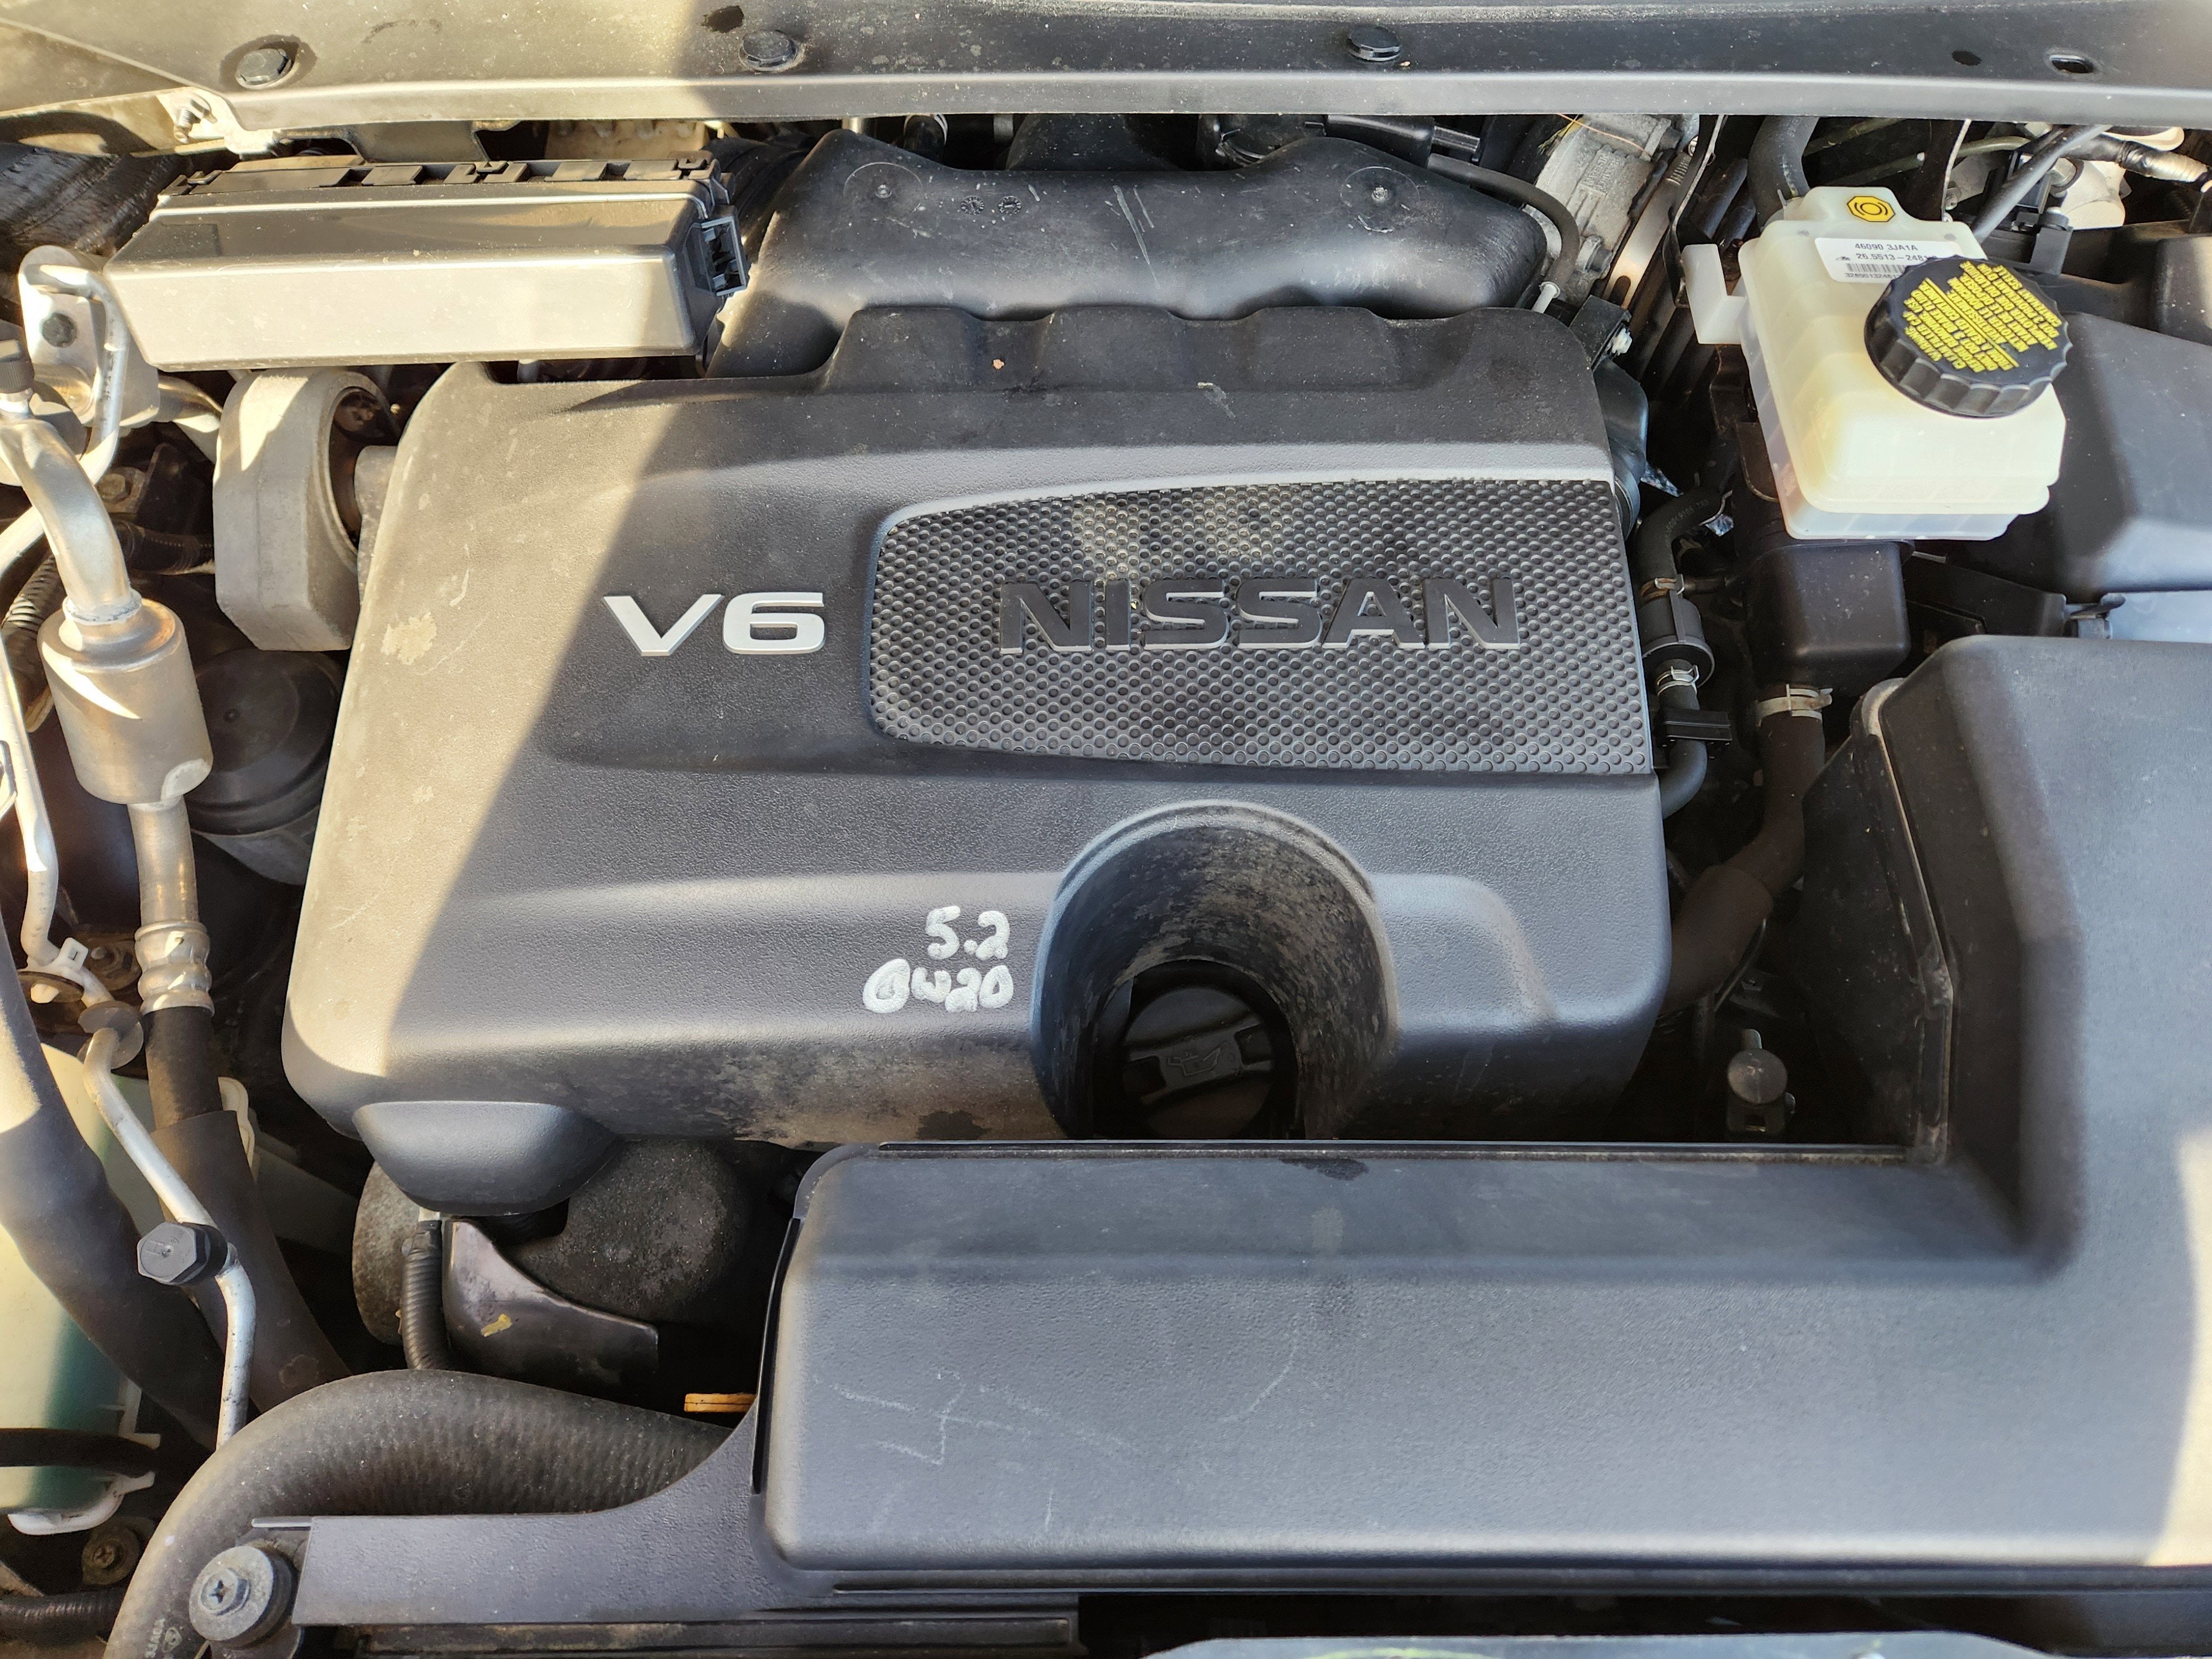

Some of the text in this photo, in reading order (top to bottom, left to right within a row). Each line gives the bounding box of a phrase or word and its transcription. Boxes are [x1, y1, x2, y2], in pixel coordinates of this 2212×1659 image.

[1959, 260, 1992, 287] LIQUIDE
[1984, 284, 2002, 296] DU
[1991, 278, 2039, 318] PROVENANT
[1994, 294, 2016, 310] QUE
[1903, 297, 1924, 314] USE
[1945, 277, 2030, 352] NETTOYER LE BOUCHON
[1987, 302, 2004, 313] LE
[1997, 311, 2014, 322] DE
[2016, 287, 2063, 326] CONTENANT
[1909, 289, 1999, 371] ONLY DOT 3 BRAKE FLUID
[1953, 317, 1987, 345] SEALED
[2031, 315, 2046, 324] 3
[2037, 321, 2060, 338] DOT
[1914, 324, 1945, 348] FILLER
[2006, 320, 2038, 346] AVANT
[1936, 345, 1967, 369] CLEAN
[1951, 345, 1985, 372] BEFORE
[1979, 342, 1994, 351] A
[1985, 348, 2014, 371] FROM
[602, 592, 826, 656] V6
[999, 577, 1520, 655] NISSAN
[925, 905, 1010, 960] 5.2
